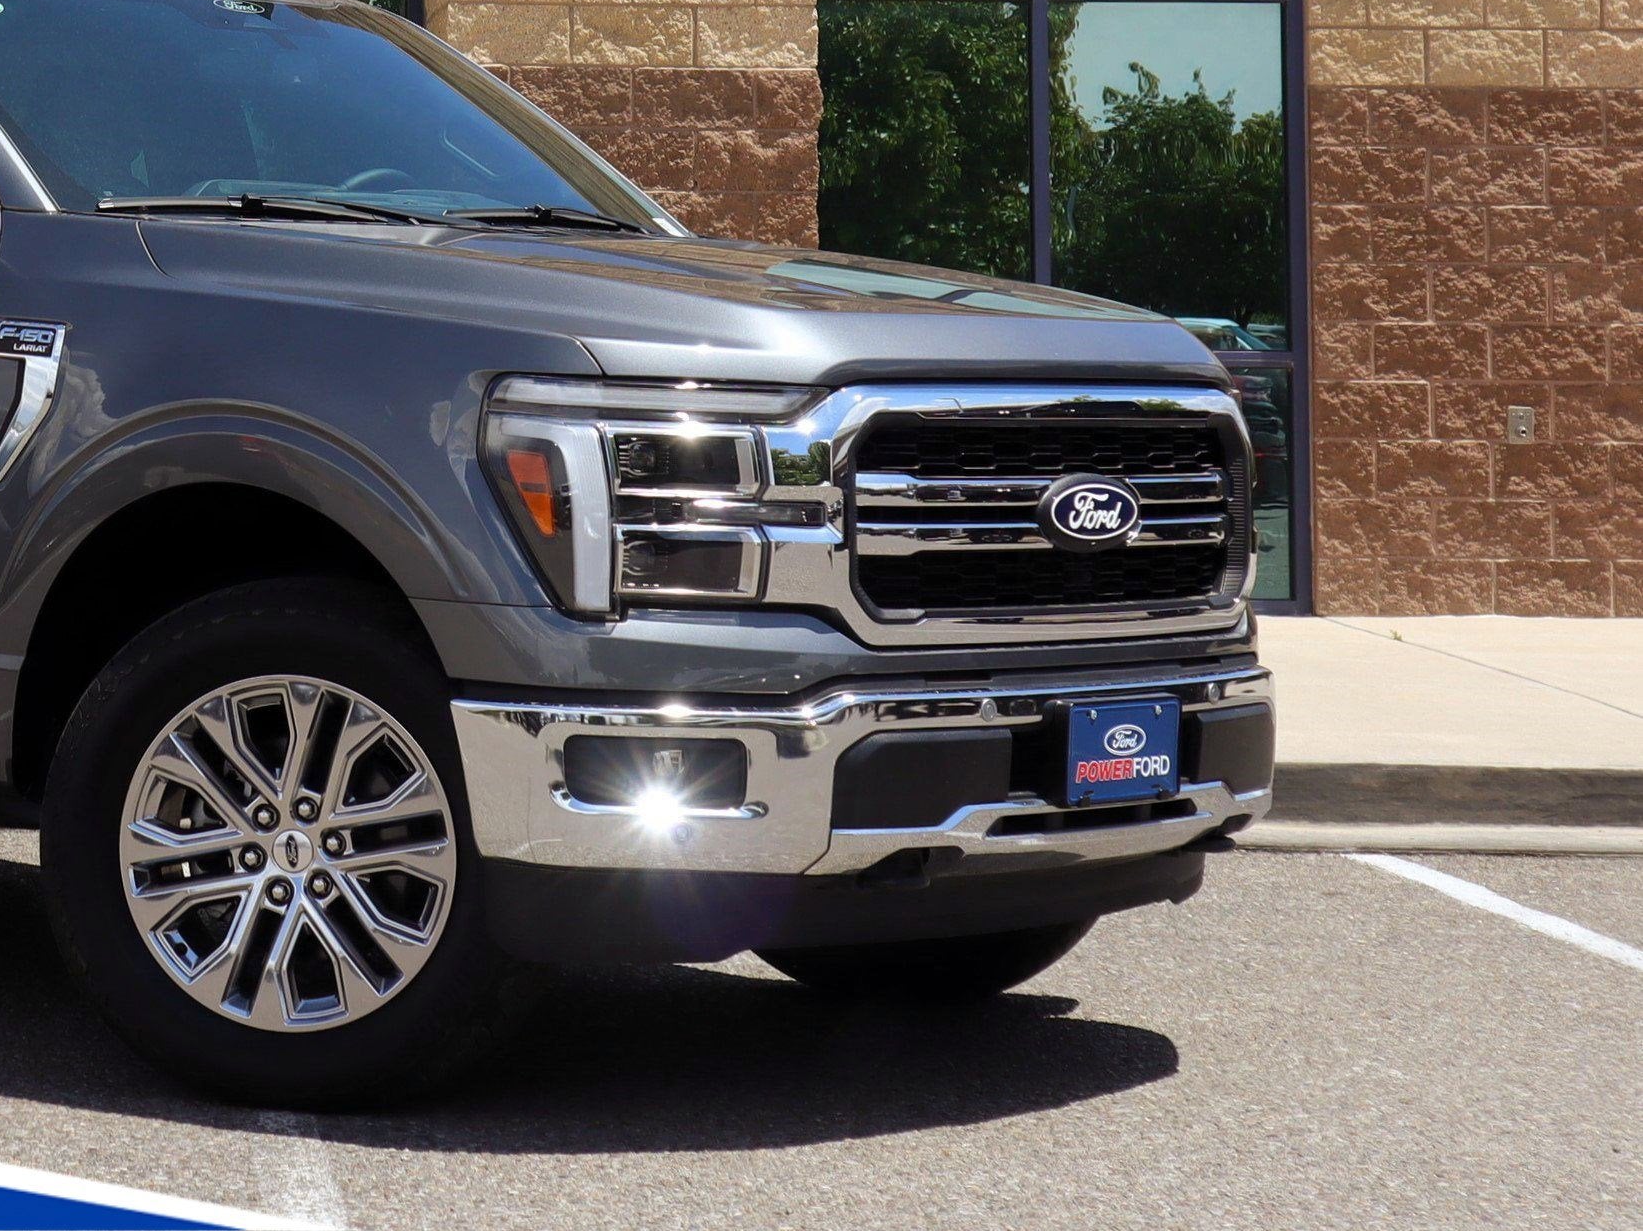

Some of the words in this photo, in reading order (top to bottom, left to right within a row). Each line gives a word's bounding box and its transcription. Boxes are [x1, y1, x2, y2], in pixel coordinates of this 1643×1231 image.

[223, 0, 257, 11] Ford
[0, 327, 54, 343] F-150
[13, 342, 48, 353] LARIAT
[1069, 492, 1122, 529] Ford
[1112, 730, 1138, 749] Ford
